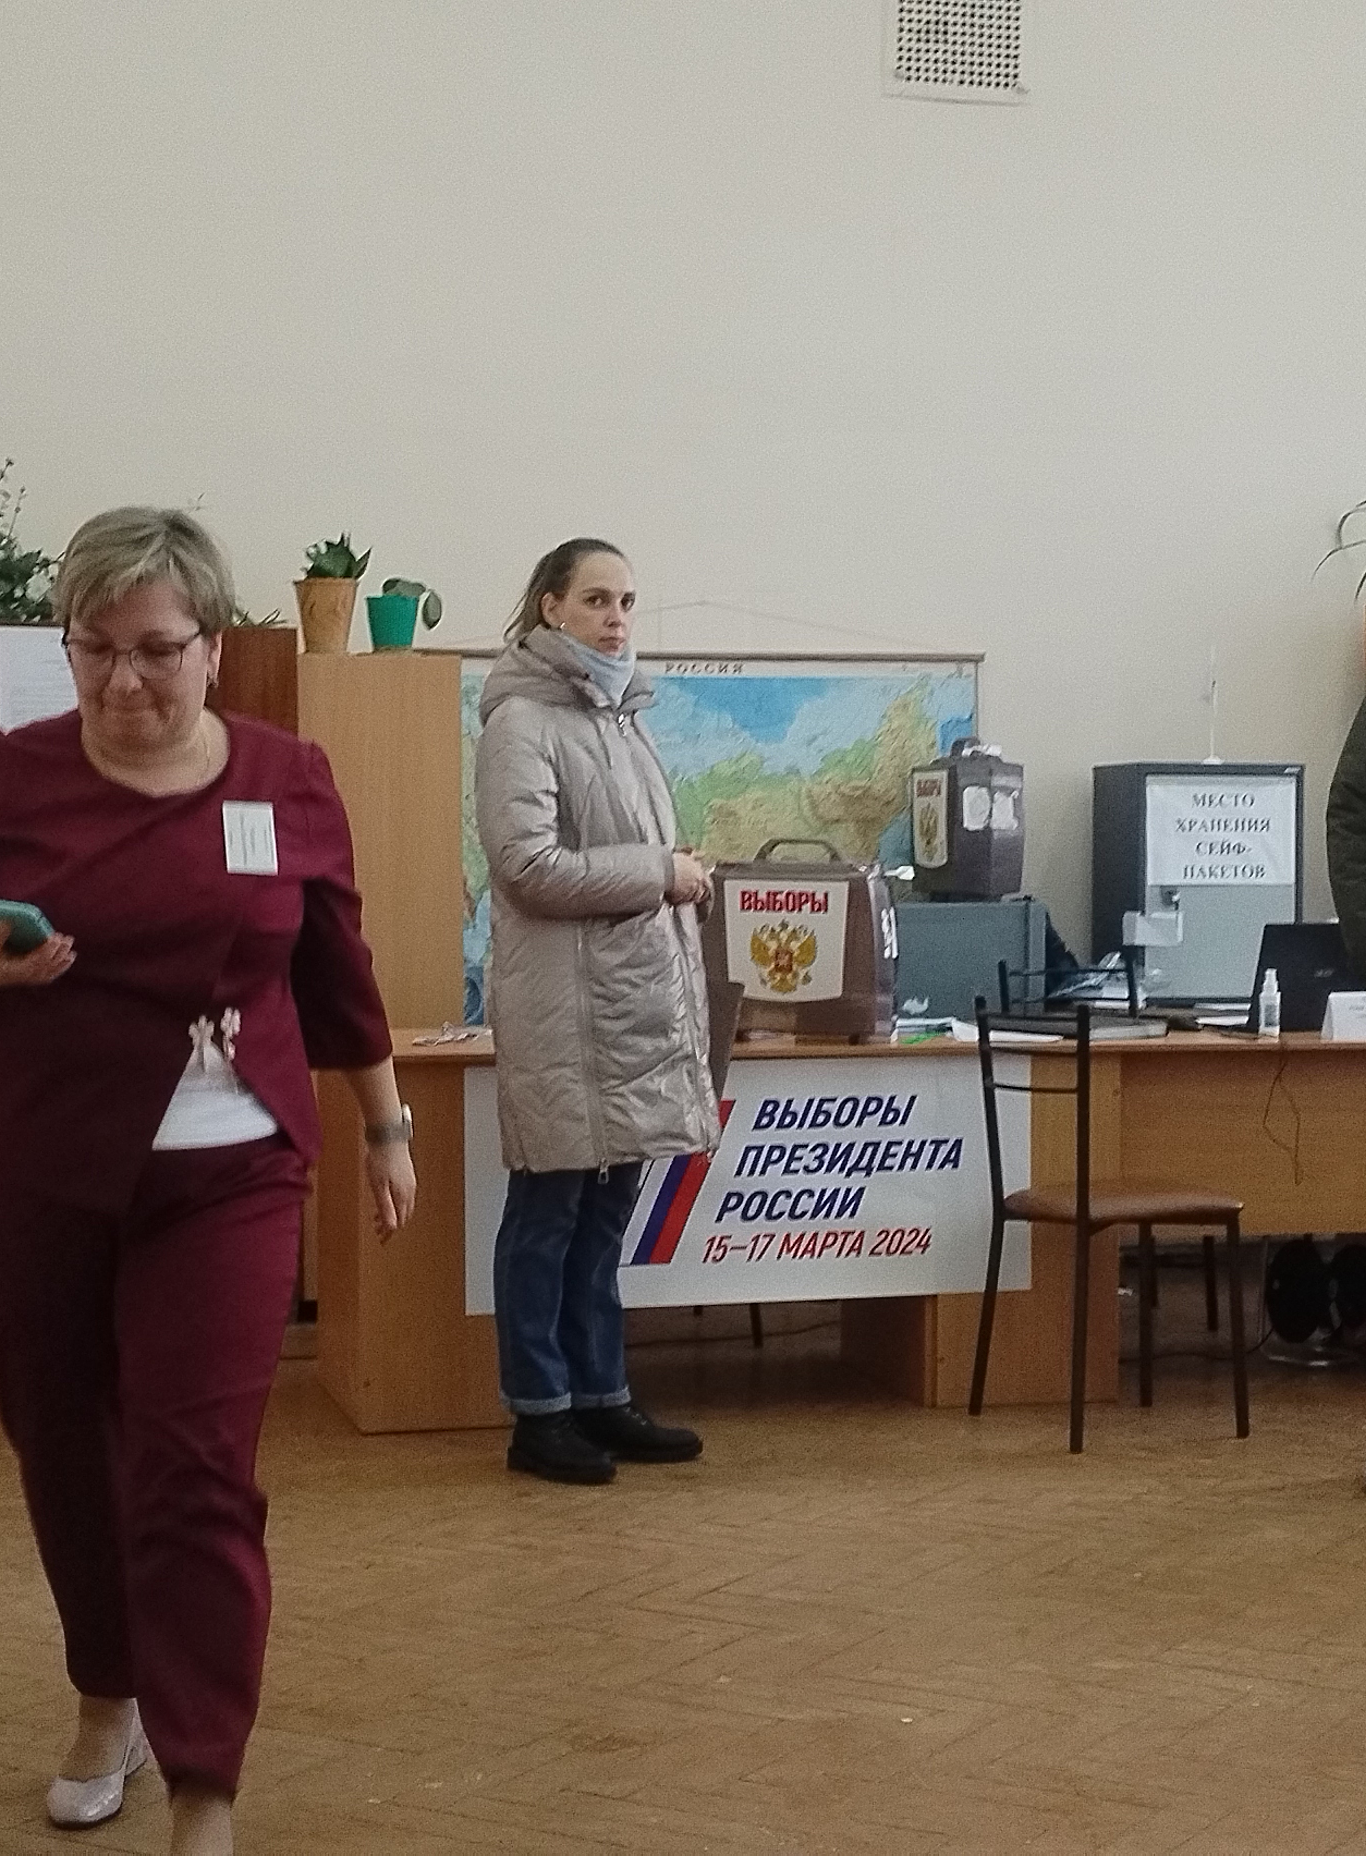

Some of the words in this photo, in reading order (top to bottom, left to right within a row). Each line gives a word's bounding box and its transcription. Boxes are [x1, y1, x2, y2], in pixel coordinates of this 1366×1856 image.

[1191, 793, 1255, 808] МЕСТО
[1174, 817, 1271, 833] ХРАНЕНИЯ
[1195, 839, 1252, 857] СЕЙФ-
[1183, 864, 1267, 880] ПАКЕТОВ
[739, 889, 829, 914] ВЫБОРЫ
[751, 1094, 918, 1132] ВЫБОРЫ
[733, 1136, 965, 1179] ПРЕЗИДЕНТА
[714, 1185, 867, 1224] РОССИИ
[776, 1229, 867, 1261] МАРТА
[868, 1226, 933, 1257] 2024
